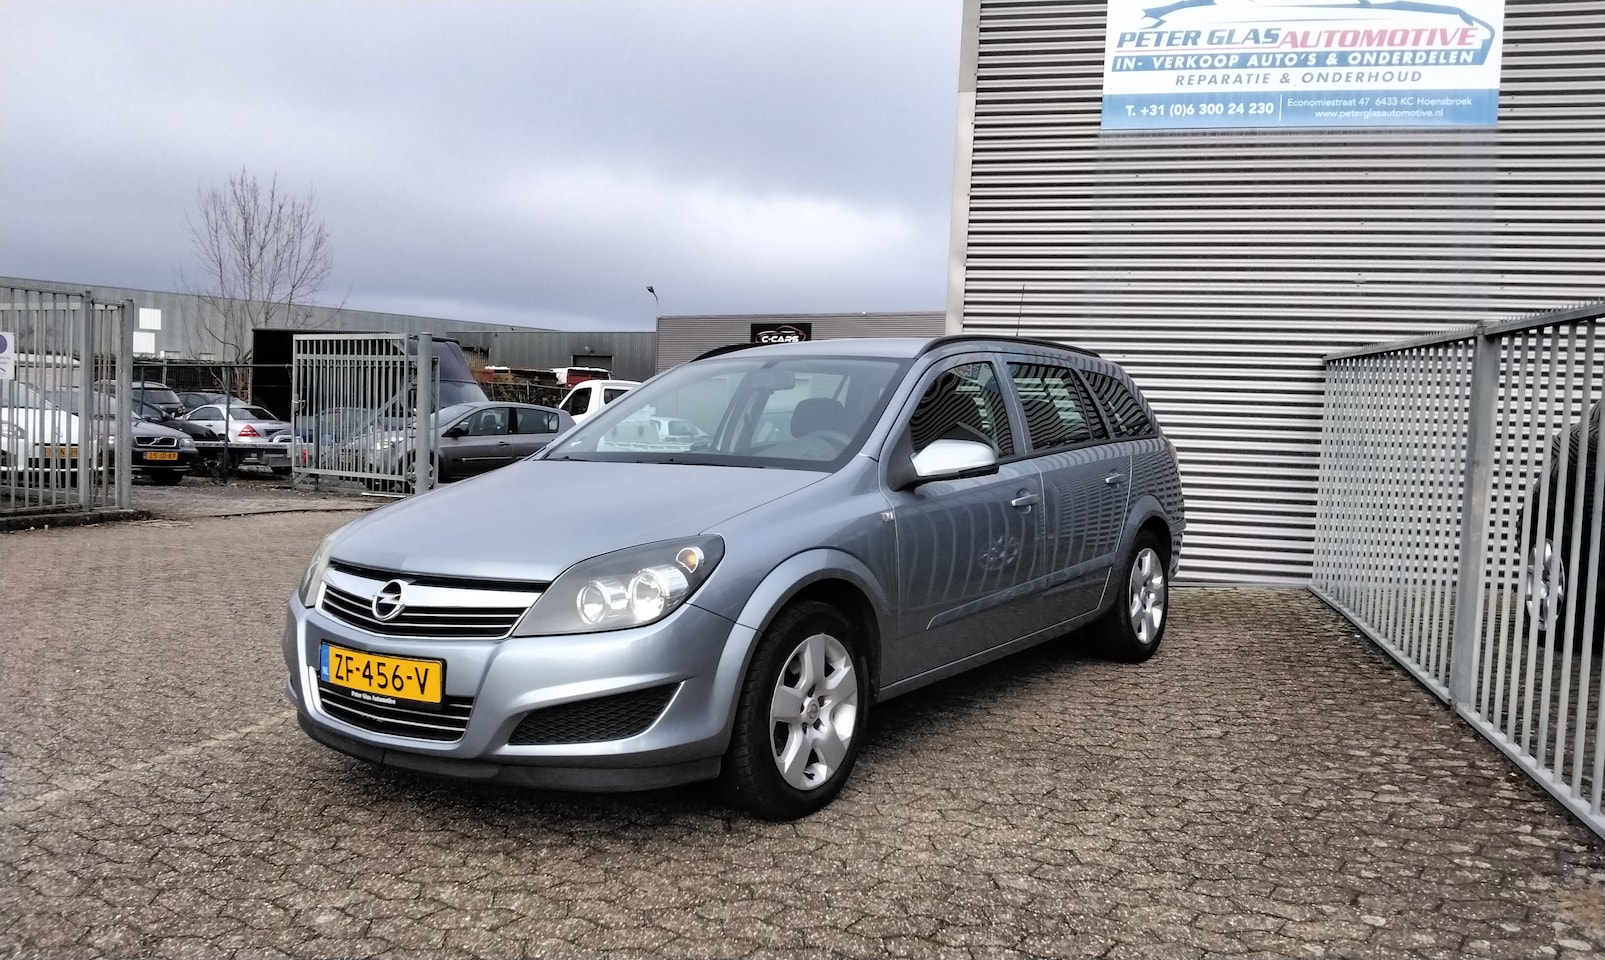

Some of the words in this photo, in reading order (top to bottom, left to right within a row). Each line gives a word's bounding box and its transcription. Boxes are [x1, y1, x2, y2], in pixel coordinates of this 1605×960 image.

[1117, 30, 1202, 48] PETER
[1115, 57, 1143, 70] IN-
[1152, 55, 1239, 68] VERKOOP
[1246, 53, 1317, 67] AUTO'S
[1325, 53, 1338, 65] &
[1347, 50, 1474, 65] ONDERDELEN
[1175, 73, 1271, 86] REPARATIE
[1279, 72, 1291, 84] &
[1301, 71, 1422, 84] ONDERHOUD
[1287, 98, 1357, 107] Economiestraat
[1358, 98, 1370, 106] 47
[1375, 97, 1398, 106] 6433
[1400, 97, 1414, 106] KC
[1416, 96, 1472, 106] Hoensbroek
[1126, 105, 1136, 116] T.
[1140, 104, 1165, 116] +31
[1169, 103, 1195, 117] (0)6
[1199, 103, 1224, 115] 300
[1228, 103, 1245, 115] 24
[1248, 102, 1274, 114] 230
[1315, 108, 1444, 119] www.peterglasautomotive.nl
[761, 335, 799, 343] C-CARS
[335, 653, 429, 695] ZF-456-V
